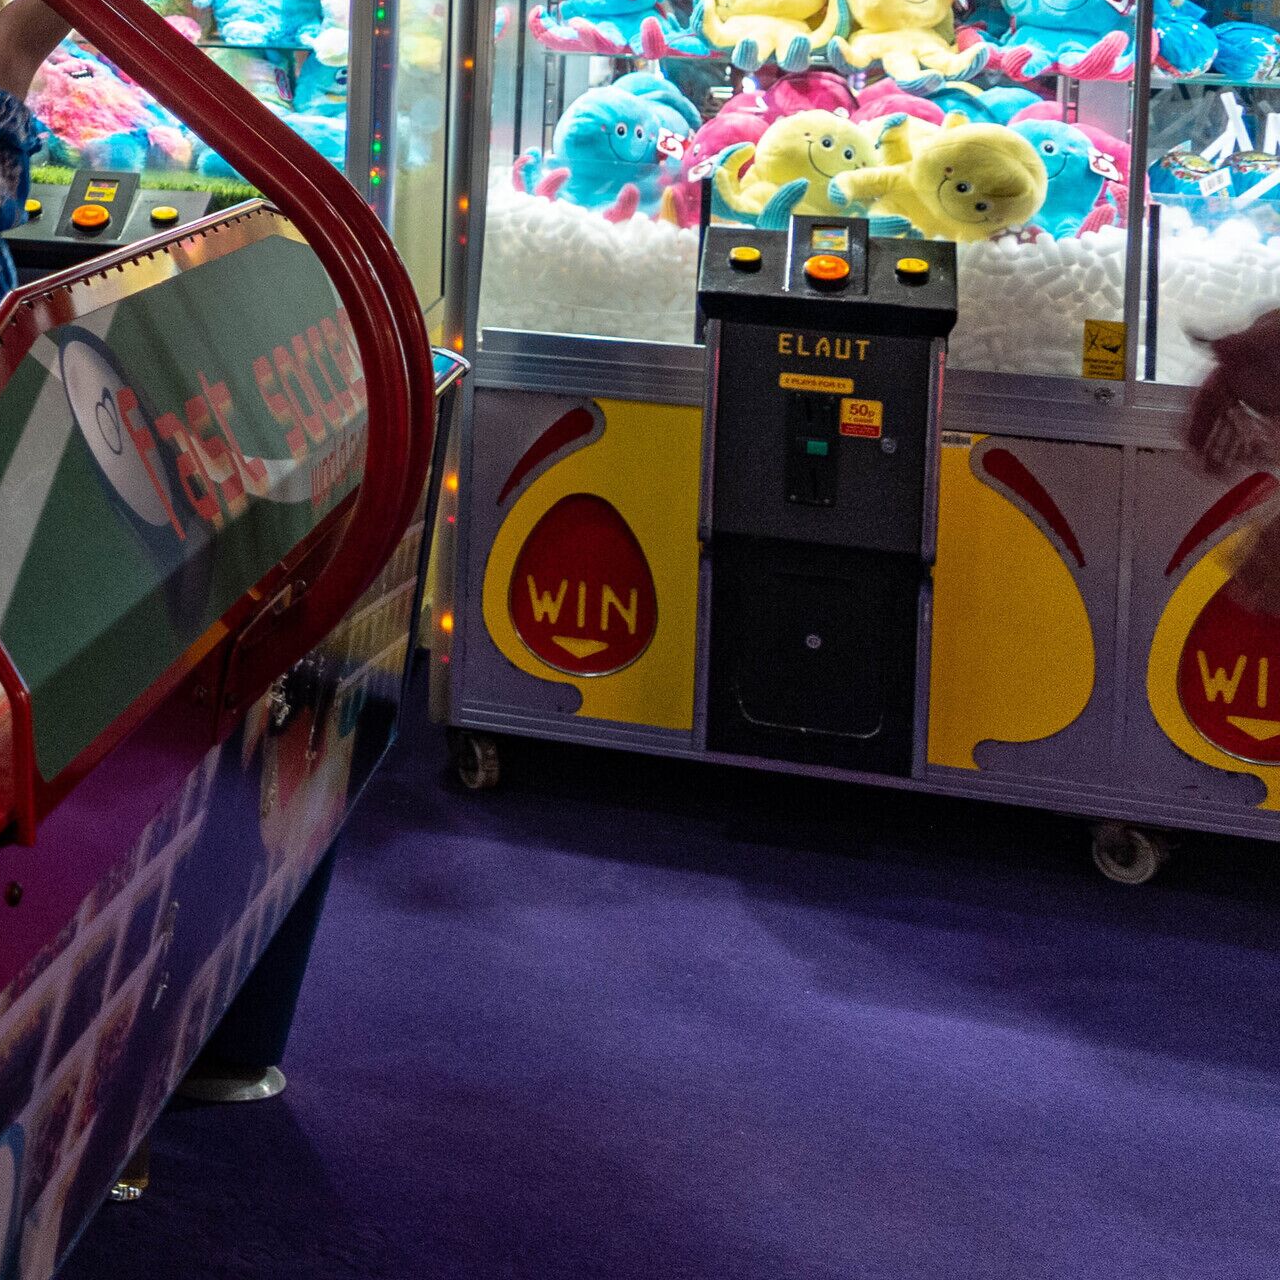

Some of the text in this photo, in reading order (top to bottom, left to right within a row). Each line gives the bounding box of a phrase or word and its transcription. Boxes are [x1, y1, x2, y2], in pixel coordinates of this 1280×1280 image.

[777, 331, 872, 361] ELAUT
[849, 403, 875, 418] 50p
[527, 574, 638, 635] WIN
[1196, 649, 1269, 709] WI
